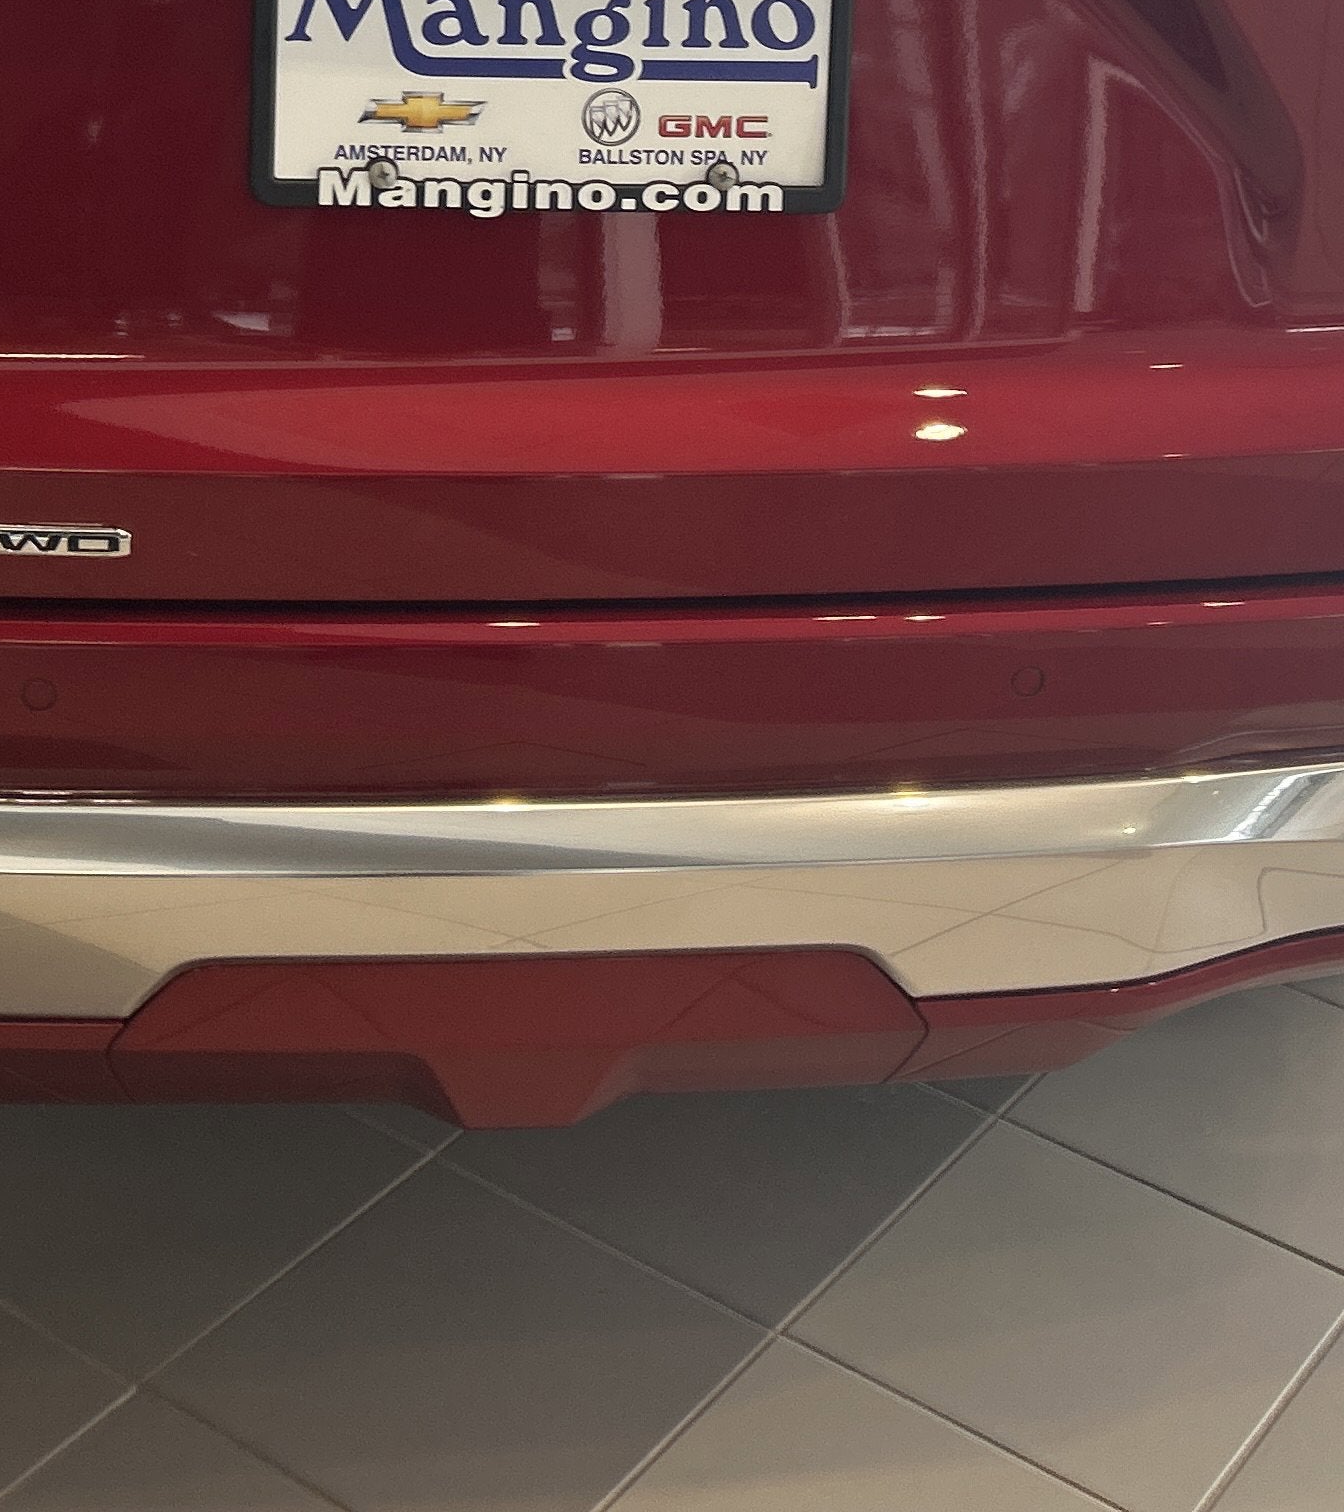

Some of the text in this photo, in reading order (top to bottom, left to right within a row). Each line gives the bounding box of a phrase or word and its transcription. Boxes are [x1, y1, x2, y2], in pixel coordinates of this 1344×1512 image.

[658, 114, 769, 139] GMC
[334, 144, 507, 165] AMSTERDAM, NY
[578, 149, 685, 165] BALLSTON
[741, 150, 768, 165] NY
[317, 169, 784, 219] Mangino.com
